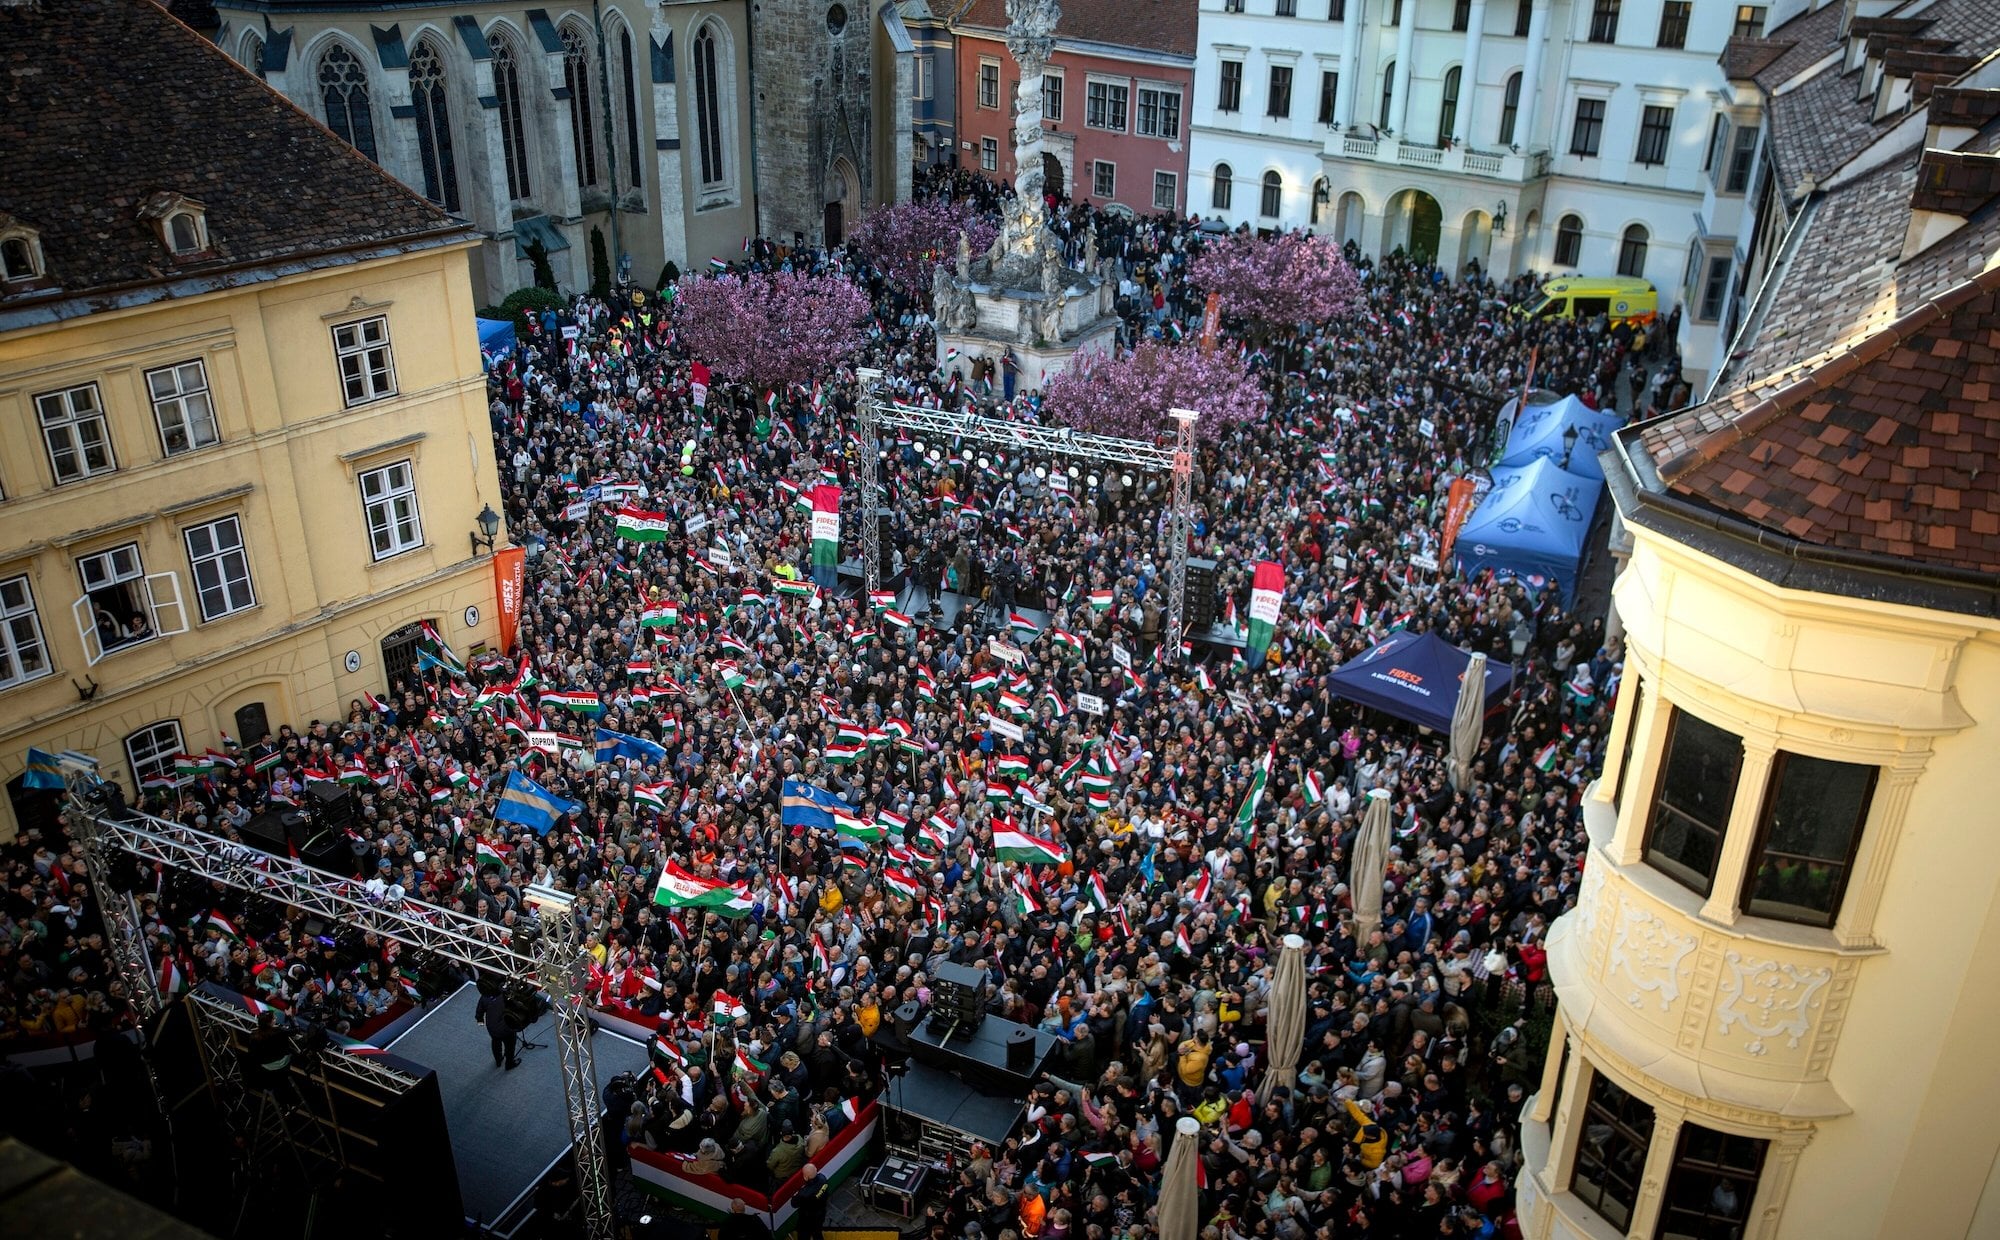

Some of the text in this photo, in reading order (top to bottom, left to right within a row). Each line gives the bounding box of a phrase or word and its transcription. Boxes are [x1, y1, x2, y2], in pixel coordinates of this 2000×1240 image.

[569, 505, 587, 516] SOPRON
[816, 517, 838, 526] FIDESZ
[513, 561, 521, 599] VÁLASZTÁS
[502, 579, 514, 613] FIDESZ
[1256, 595, 1280, 606] FIDESZ
[1388, 667, 1424, 685] FIDESZ
[1377, 674, 1397, 684] BIZTOS
[1397, 680, 1431, 696] VÁLASZTÁS
[531, 737, 556, 747] SOPRON
